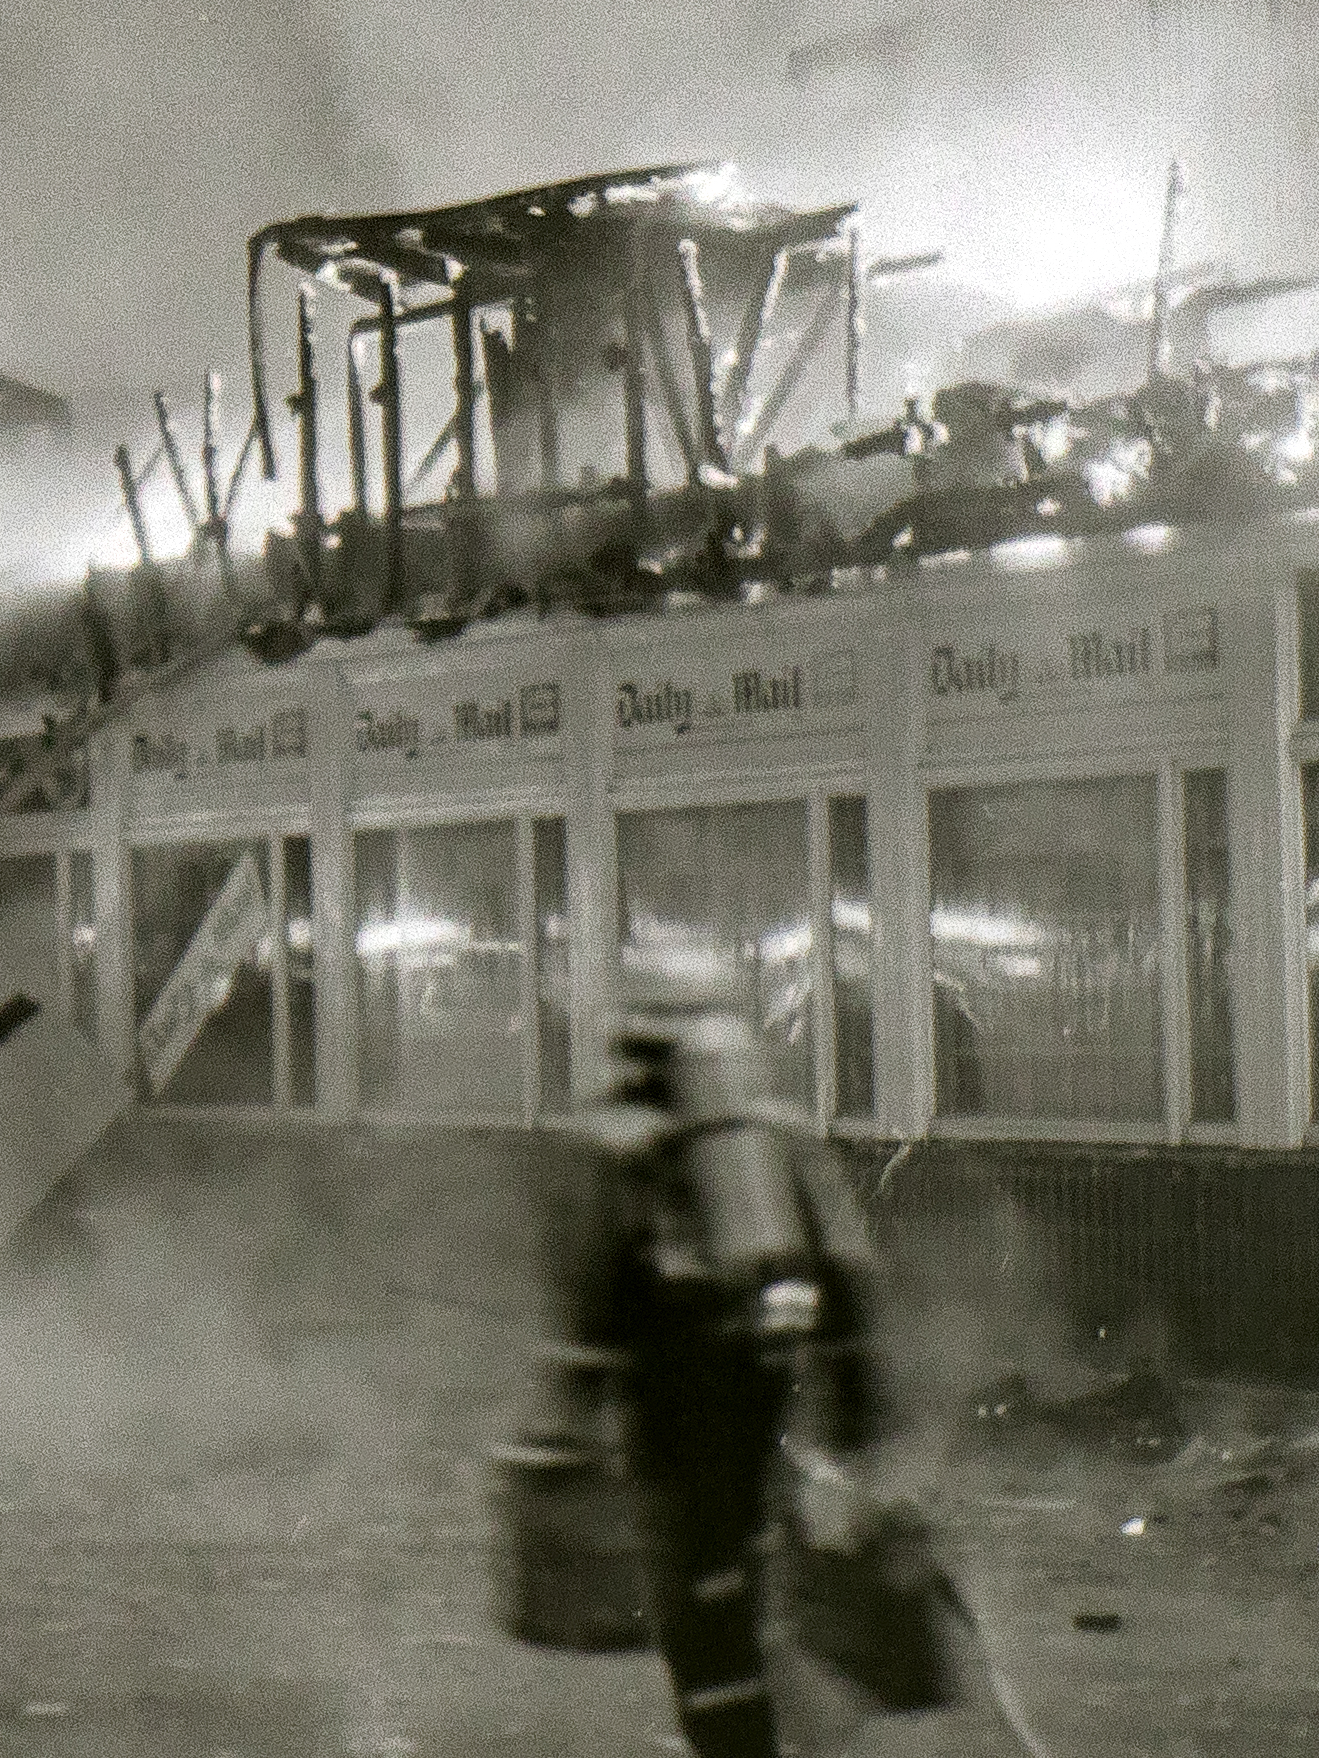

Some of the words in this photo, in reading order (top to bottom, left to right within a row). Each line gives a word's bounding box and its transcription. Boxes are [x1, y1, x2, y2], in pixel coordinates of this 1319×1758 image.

[618, 682, 691, 735] Daily
[733, 666, 801, 713] Mail
[931, 645, 1019, 705] Daily
[1069, 628, 1150, 680] Mail
[356, 709, 418, 759] Daily
[453, 700, 512, 741] Mail
